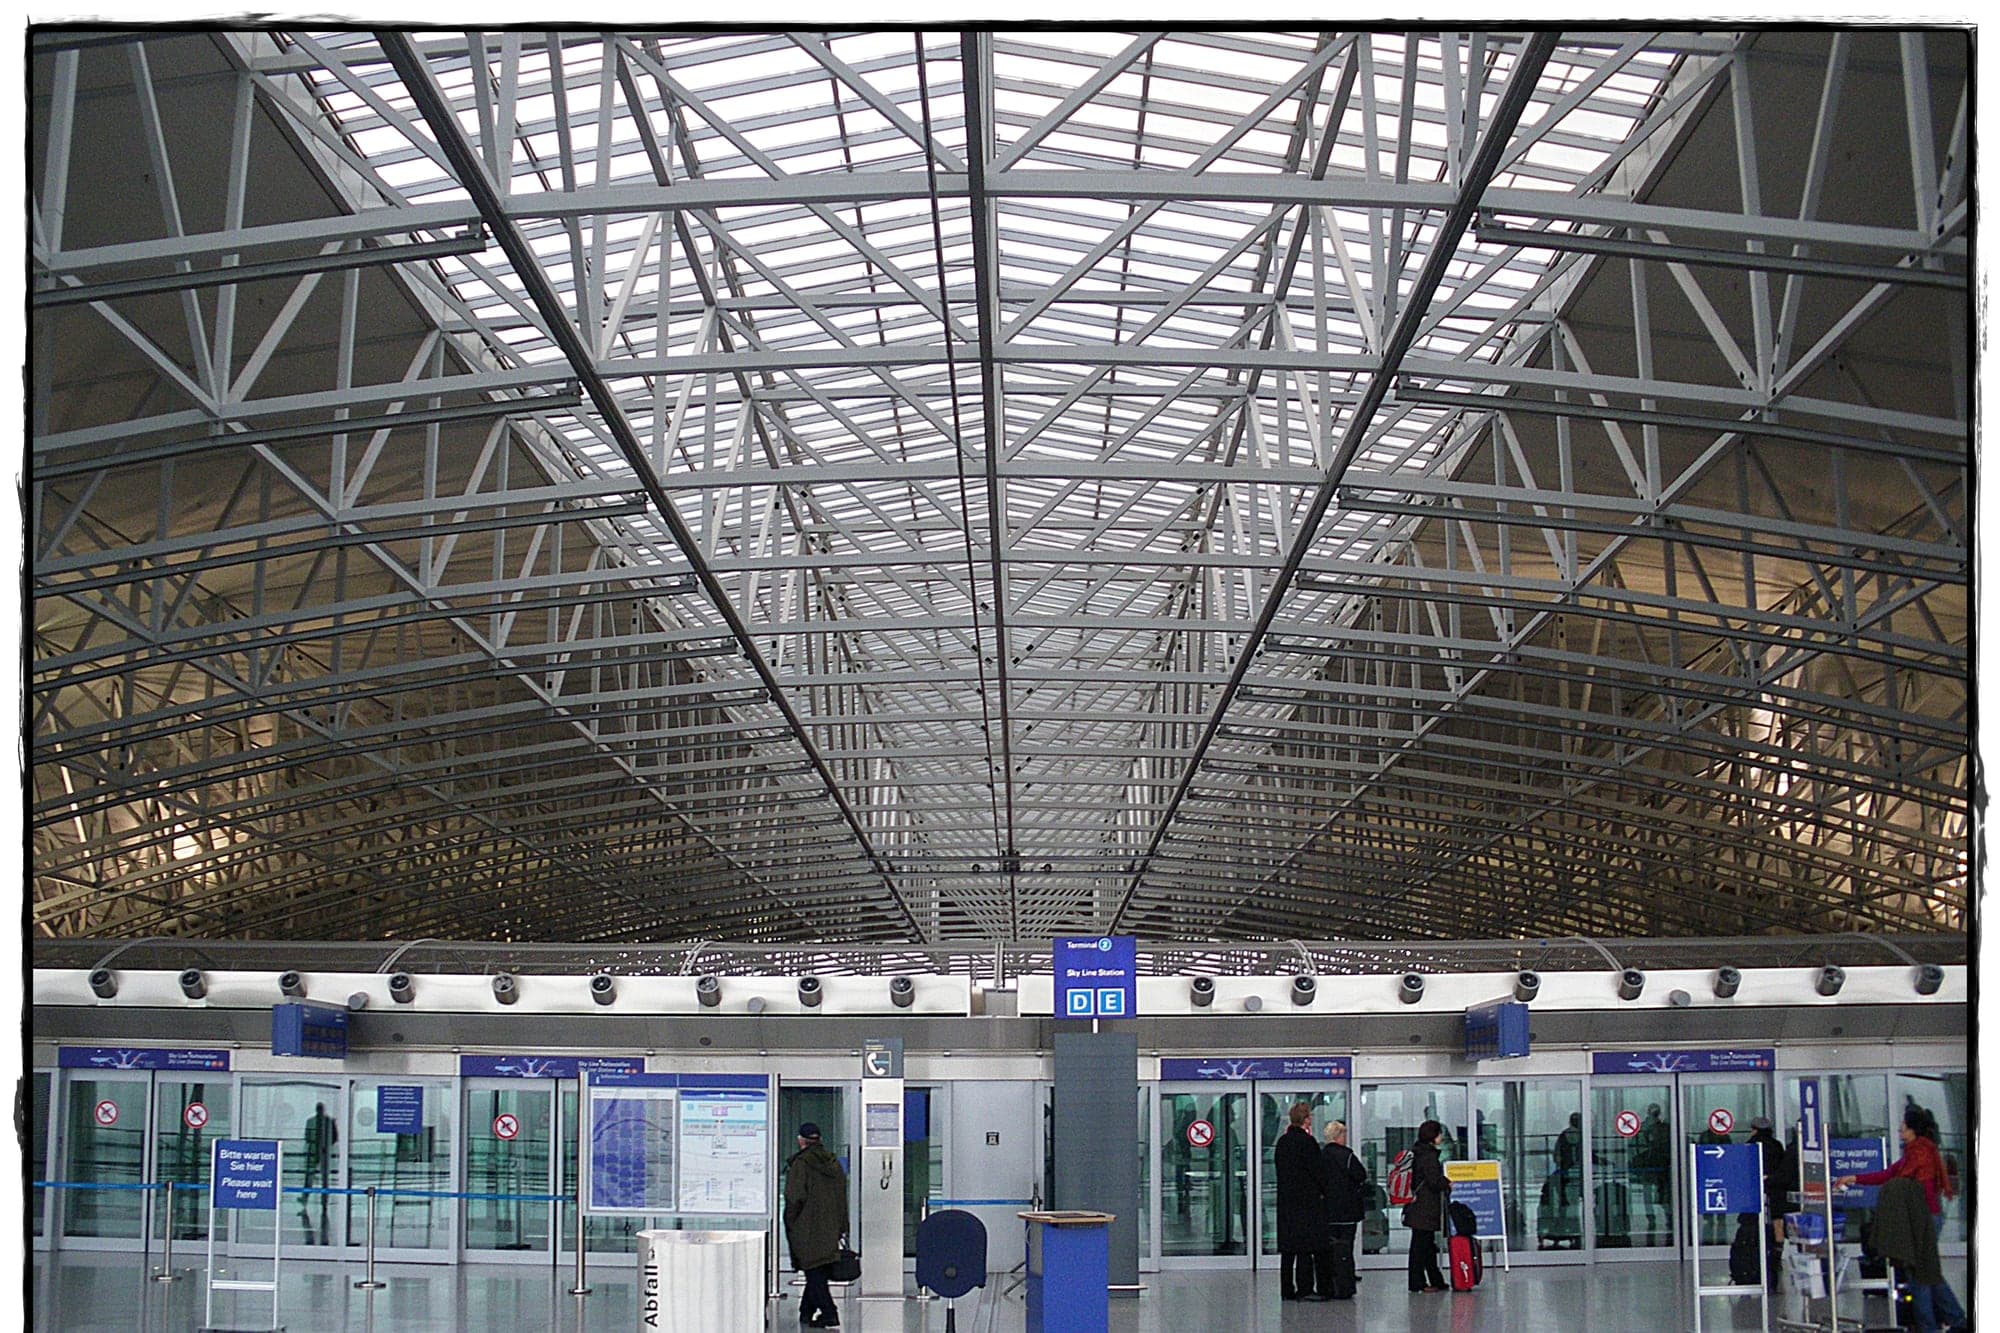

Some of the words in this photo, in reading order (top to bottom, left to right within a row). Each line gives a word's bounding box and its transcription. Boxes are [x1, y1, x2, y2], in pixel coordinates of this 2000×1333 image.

[1067, 941, 1098, 949] Terminal
[1066, 968, 1081, 978] Sky
[1081, 969, 1097, 977] Line
[1098, 968, 1125, 976] Station
[1073, 994, 1088, 1011] D
[1105, 993, 1117, 1010] E
[220, 1149, 241, 1159] Bitte
[243, 1151, 275, 1160] warten
[1847, 1149, 1878, 1159] warten
[230, 1161, 245, 1171] Sie
[246, 1161, 264, 1171] hier
[1835, 1159, 1850, 1169] Sie
[1851, 1159, 1869, 1169] hier
[221, 1177, 251, 1188] Please
[252, 1178, 272, 1188] wait
[236, 1189, 258, 1199] here
[644, 1265, 658, 1328] Abfall
